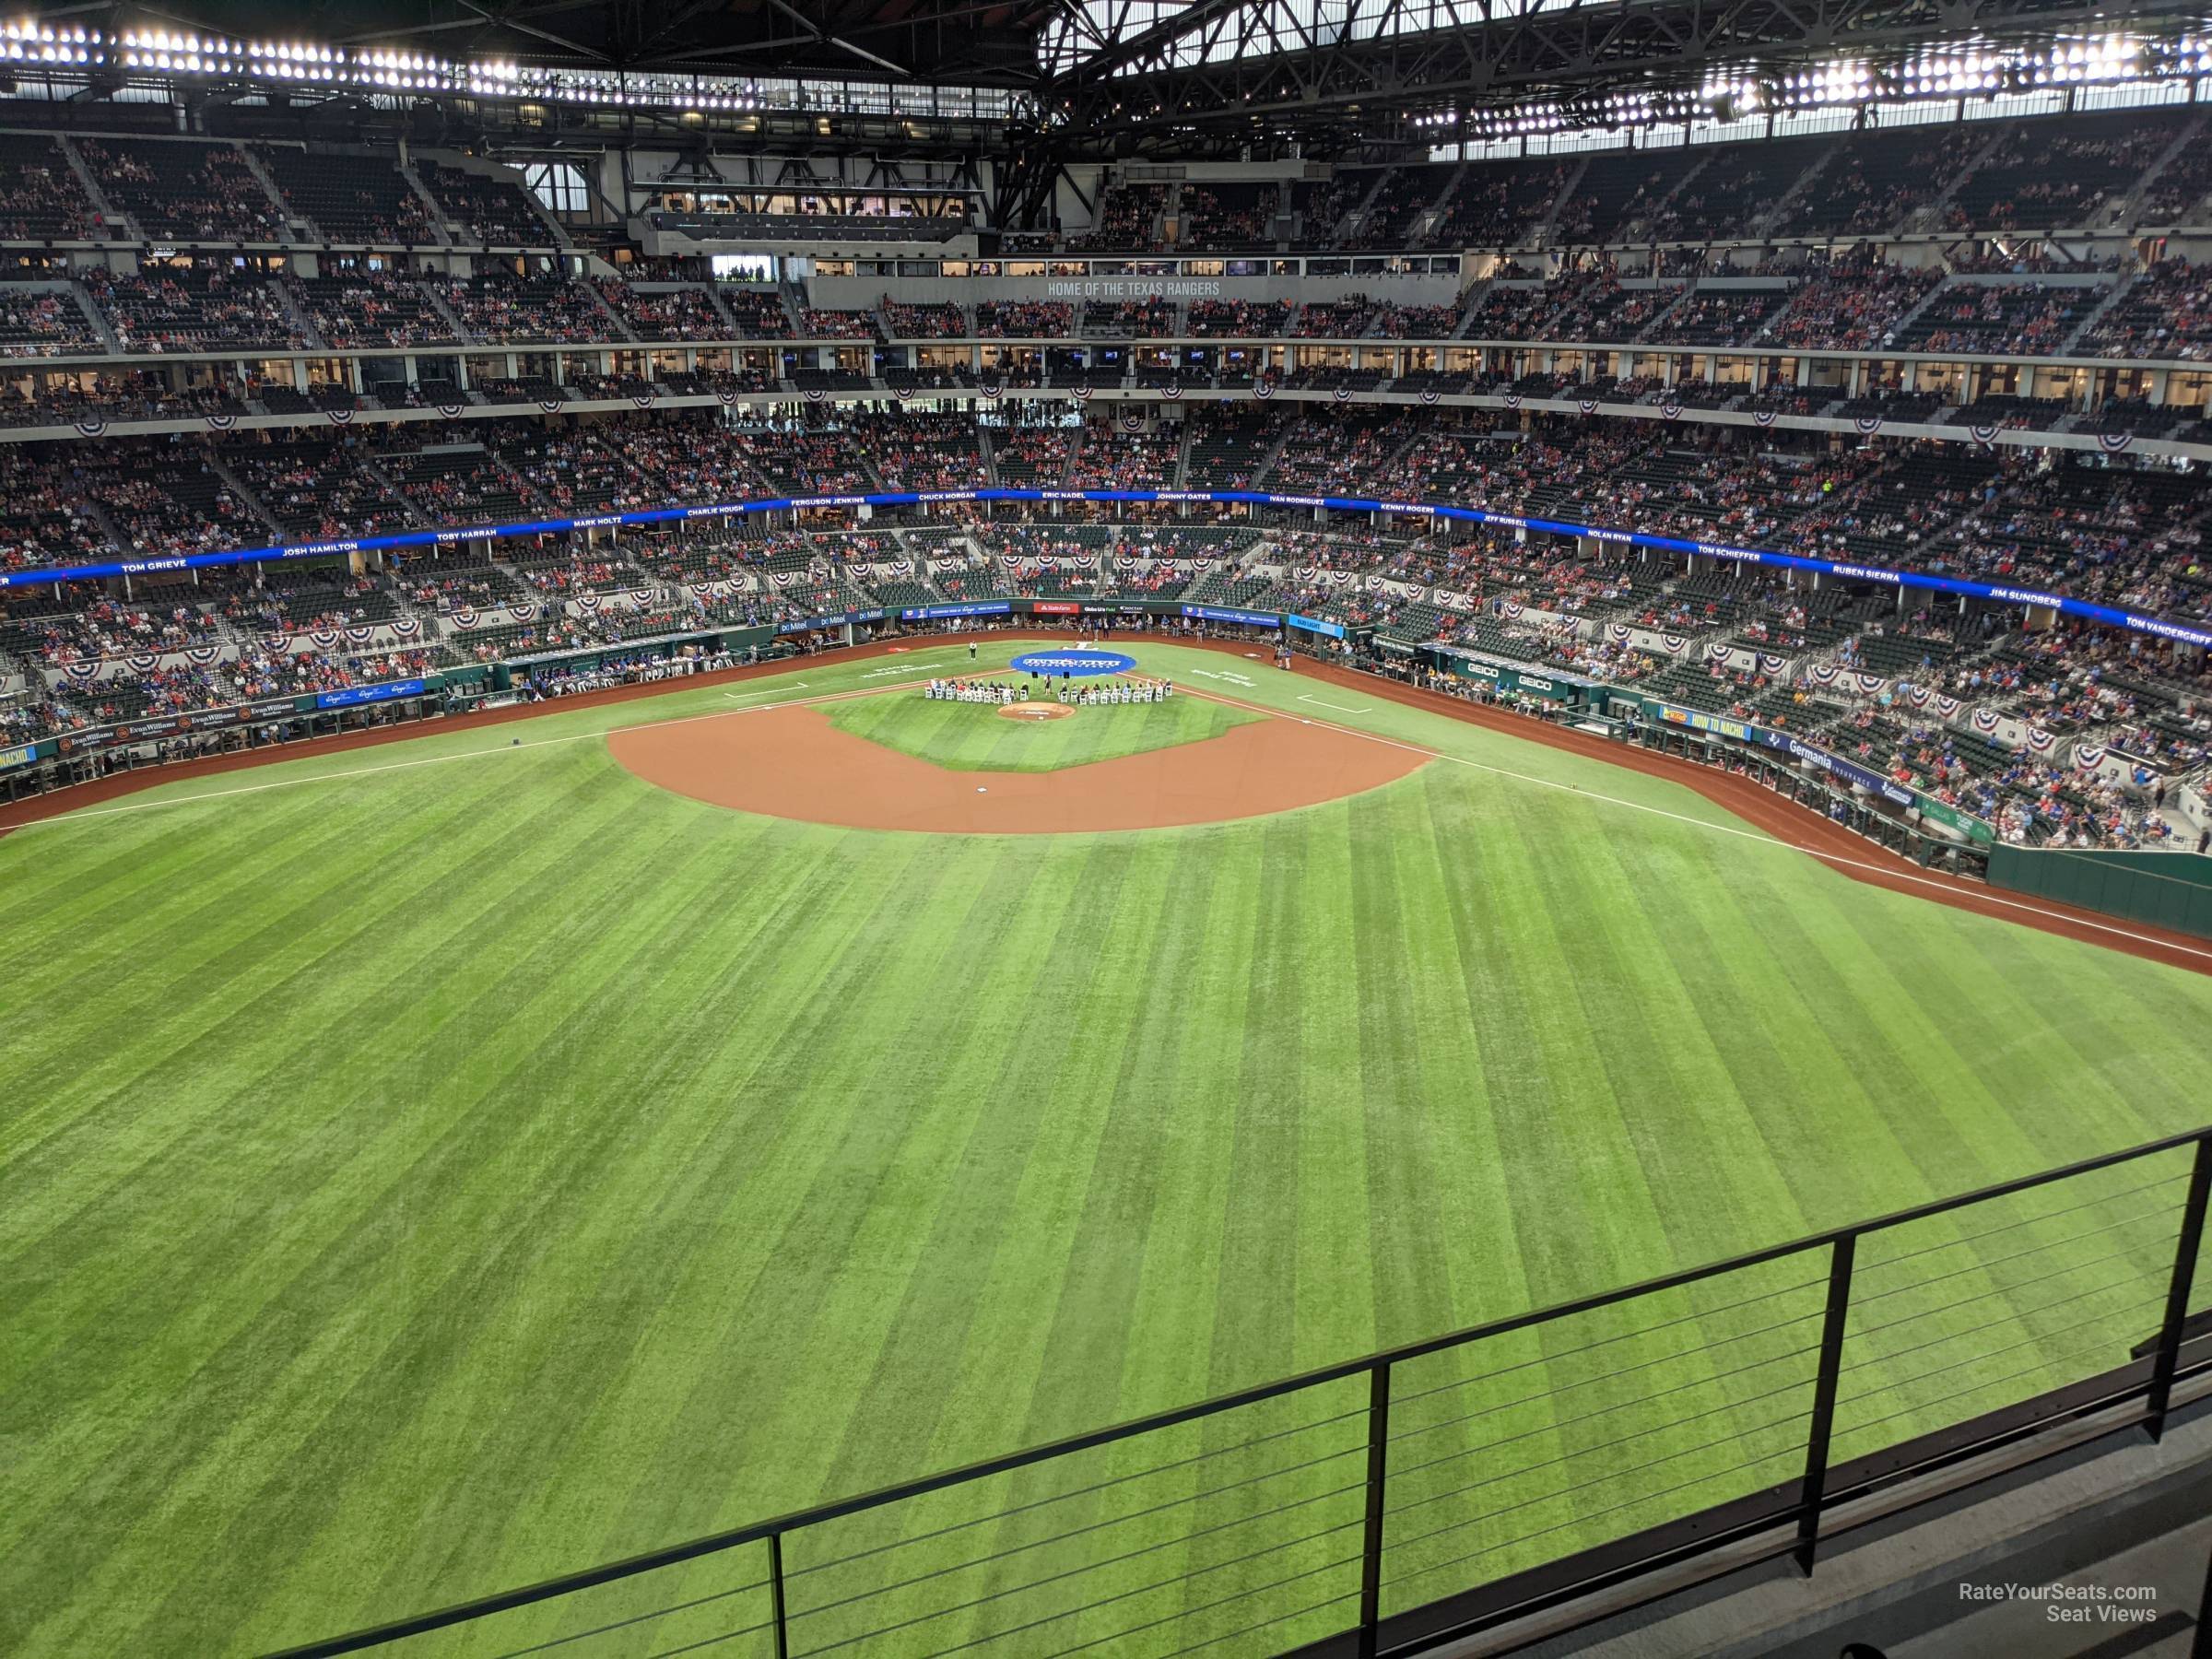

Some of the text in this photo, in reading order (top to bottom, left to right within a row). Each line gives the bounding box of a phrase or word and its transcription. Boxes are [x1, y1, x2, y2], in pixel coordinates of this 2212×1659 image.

[1048, 282, 1220, 296] HOME OF THE TEXAS RANGERS
[791, 497, 865, 506] FERGUSON JENKINS
[1286, 497, 1324, 506] RODRÍGUEZ
[720, 505, 744, 513] HOUGH
[1381, 503, 1435, 514] KENNY ROGERS
[573, 516, 622, 527] MARK HOLTZ
[1484, 515, 1528, 527] JEFF RUSSELL
[437, 529, 497, 541] TOBY HARRAH
[1587, 530, 1632, 543] NOLAN RYAN
[282, 542, 358, 557] JOSH HAMILTON
[1698, 546, 1760, 561] TOM SCHIEFFER
[122, 559, 186, 573] TOM GRIEVE
[1833, 565, 1900, 582] RUBEN SIERRA
[1989, 588, 2062, 607] JIM SUNDBERG
[867, 608, 883, 618] Mitel
[790, 621, 807, 630] Mitel
[830, 615, 846, 625] Mitel
[1467, 663, 1500, 678] GEICO
[1518, 675, 1552, 691] GEICO
[1692, 713, 1710, 729] HOW
[1711, 718, 1719, 731] TO
[1789, 738, 1831, 770] Germania
[1832, 765, 1871, 788] INSURANCE
